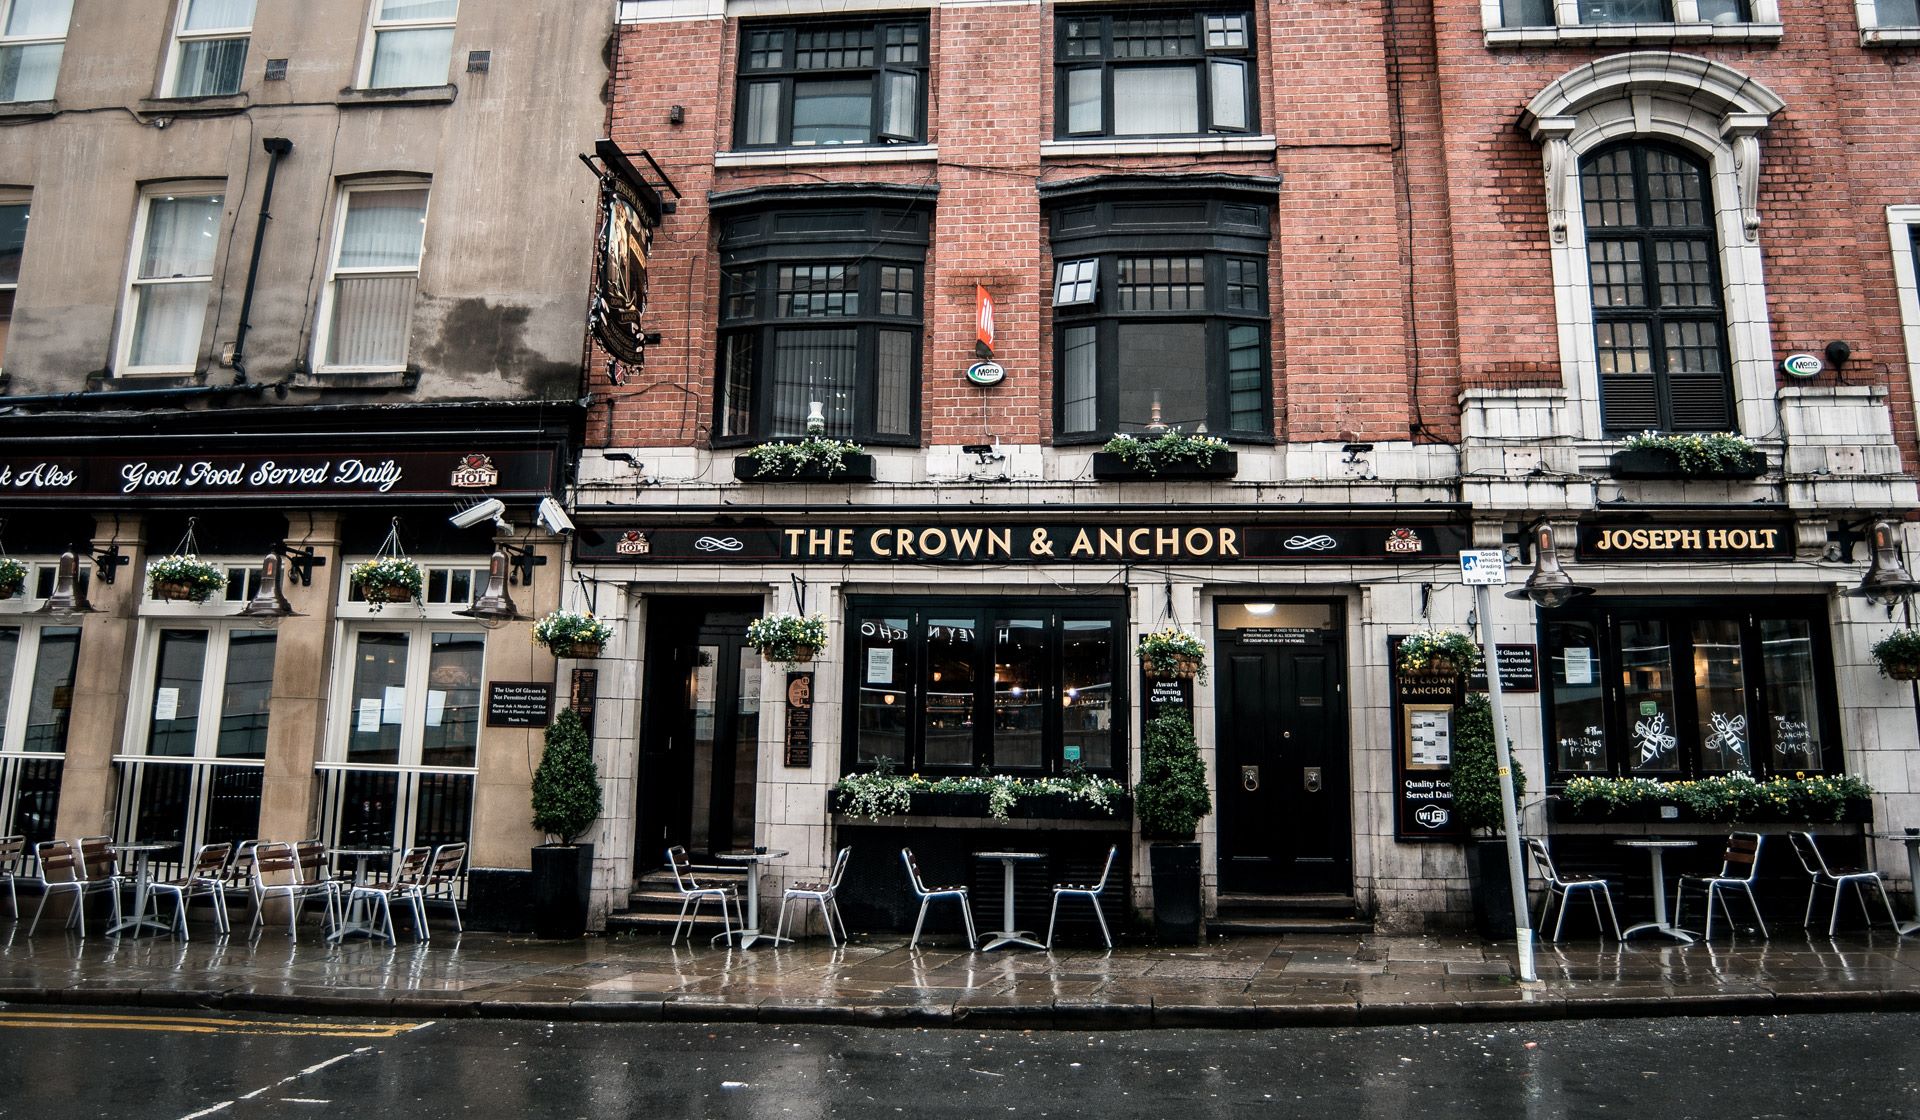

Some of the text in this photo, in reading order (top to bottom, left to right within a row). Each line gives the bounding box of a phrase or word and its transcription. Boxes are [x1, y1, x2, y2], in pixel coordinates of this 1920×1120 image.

[15, 462, 78, 486] Ales
[121, 460, 402, 493] Good Food Served Daily
[454, 474, 496, 482] HOLT
[784, 527, 1239, 557] THE CROWN & ANCHOR
[1597, 529, 1778, 550] JOSEPH HOLT
[1780, 721, 1807, 730] CROWN
[1406, 780, 1434, 789] Quality
